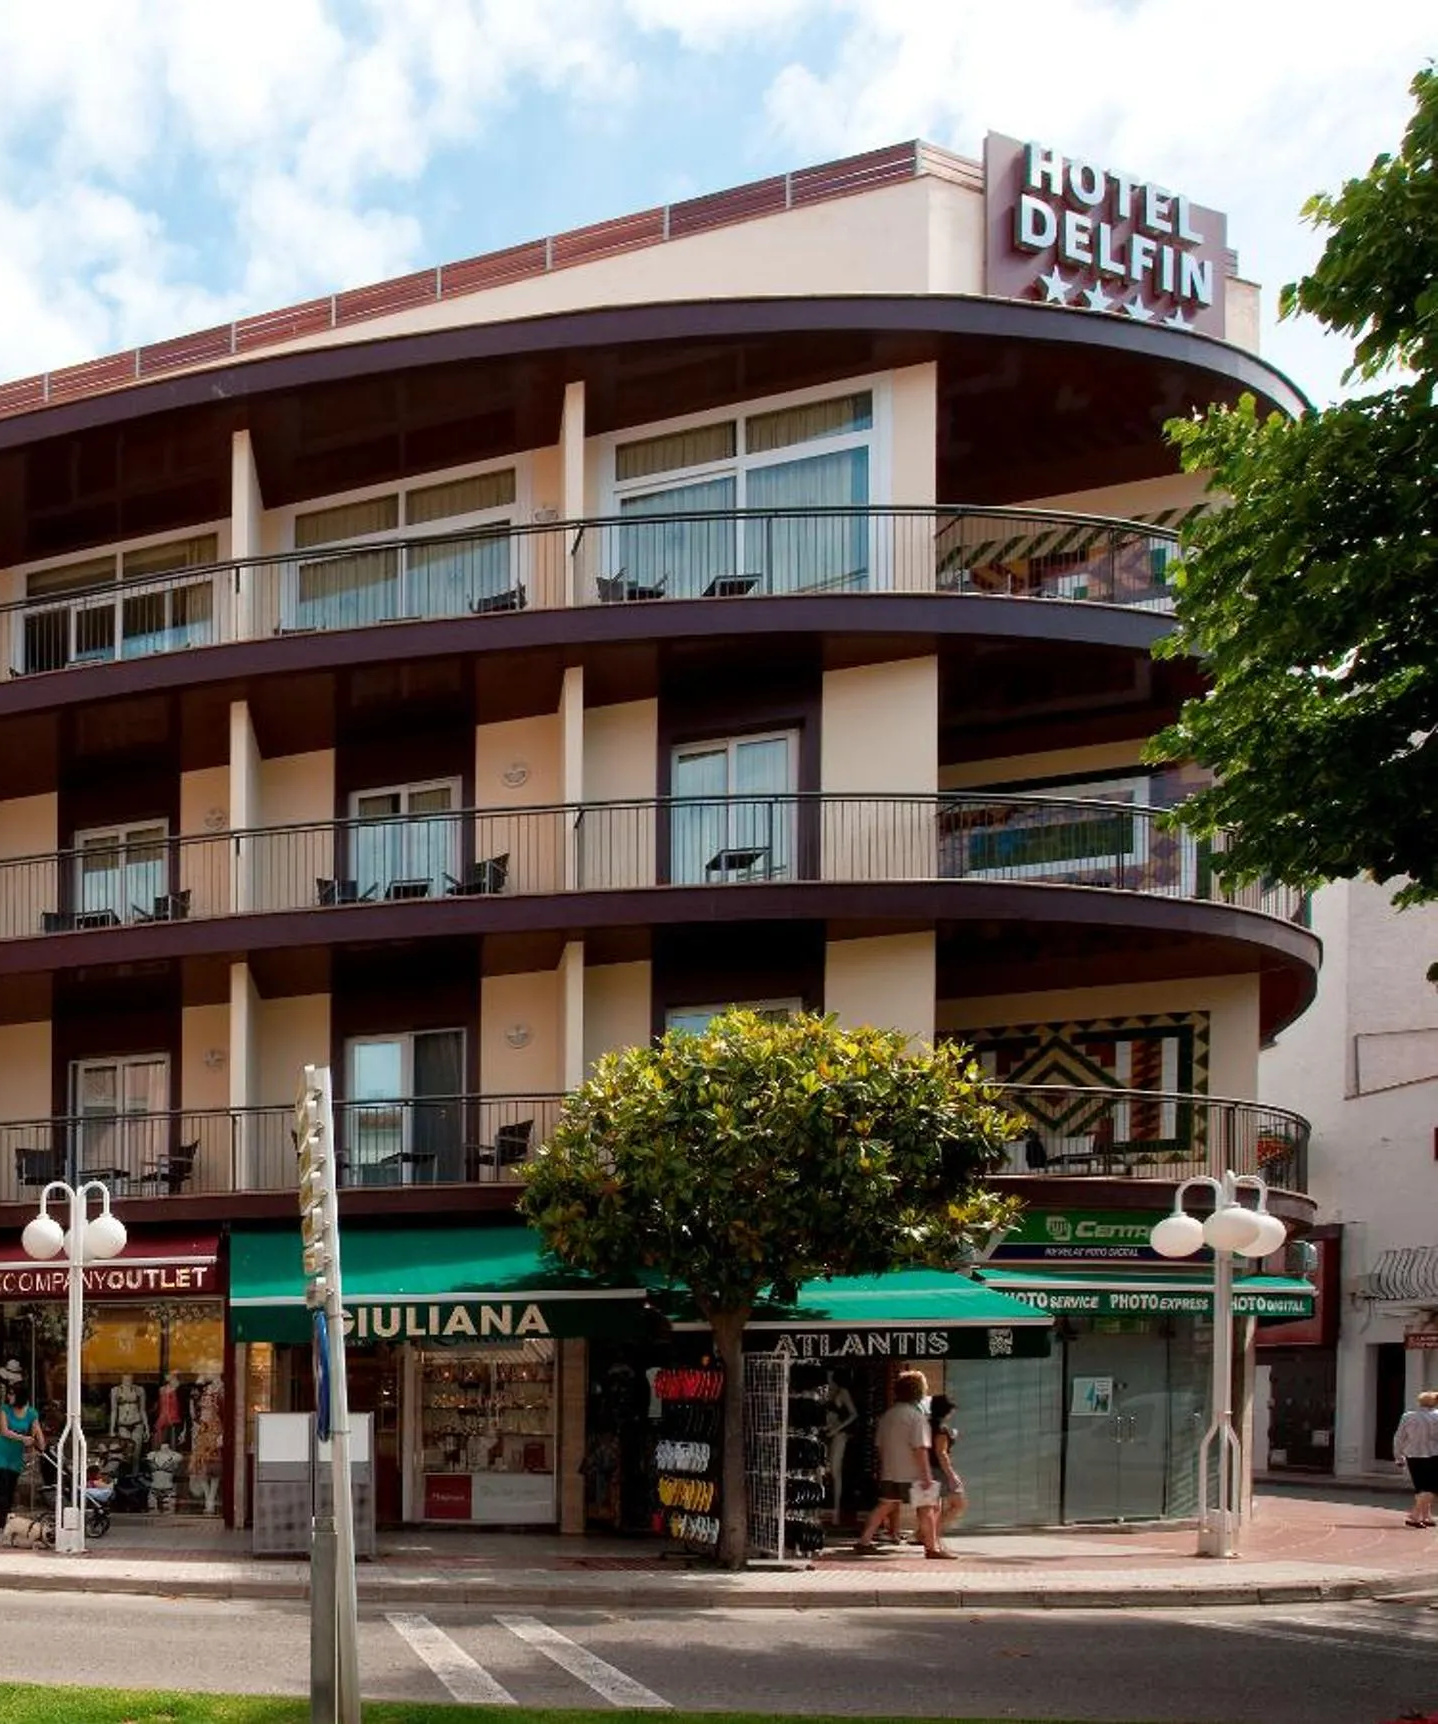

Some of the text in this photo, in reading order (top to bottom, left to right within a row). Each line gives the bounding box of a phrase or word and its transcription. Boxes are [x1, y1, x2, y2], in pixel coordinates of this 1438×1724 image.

[1024, 140, 1203, 244] HOTEL
[1020, 193, 1212, 306] DELFIN
[774, 1331, 950, 1357] ATLANTIS
